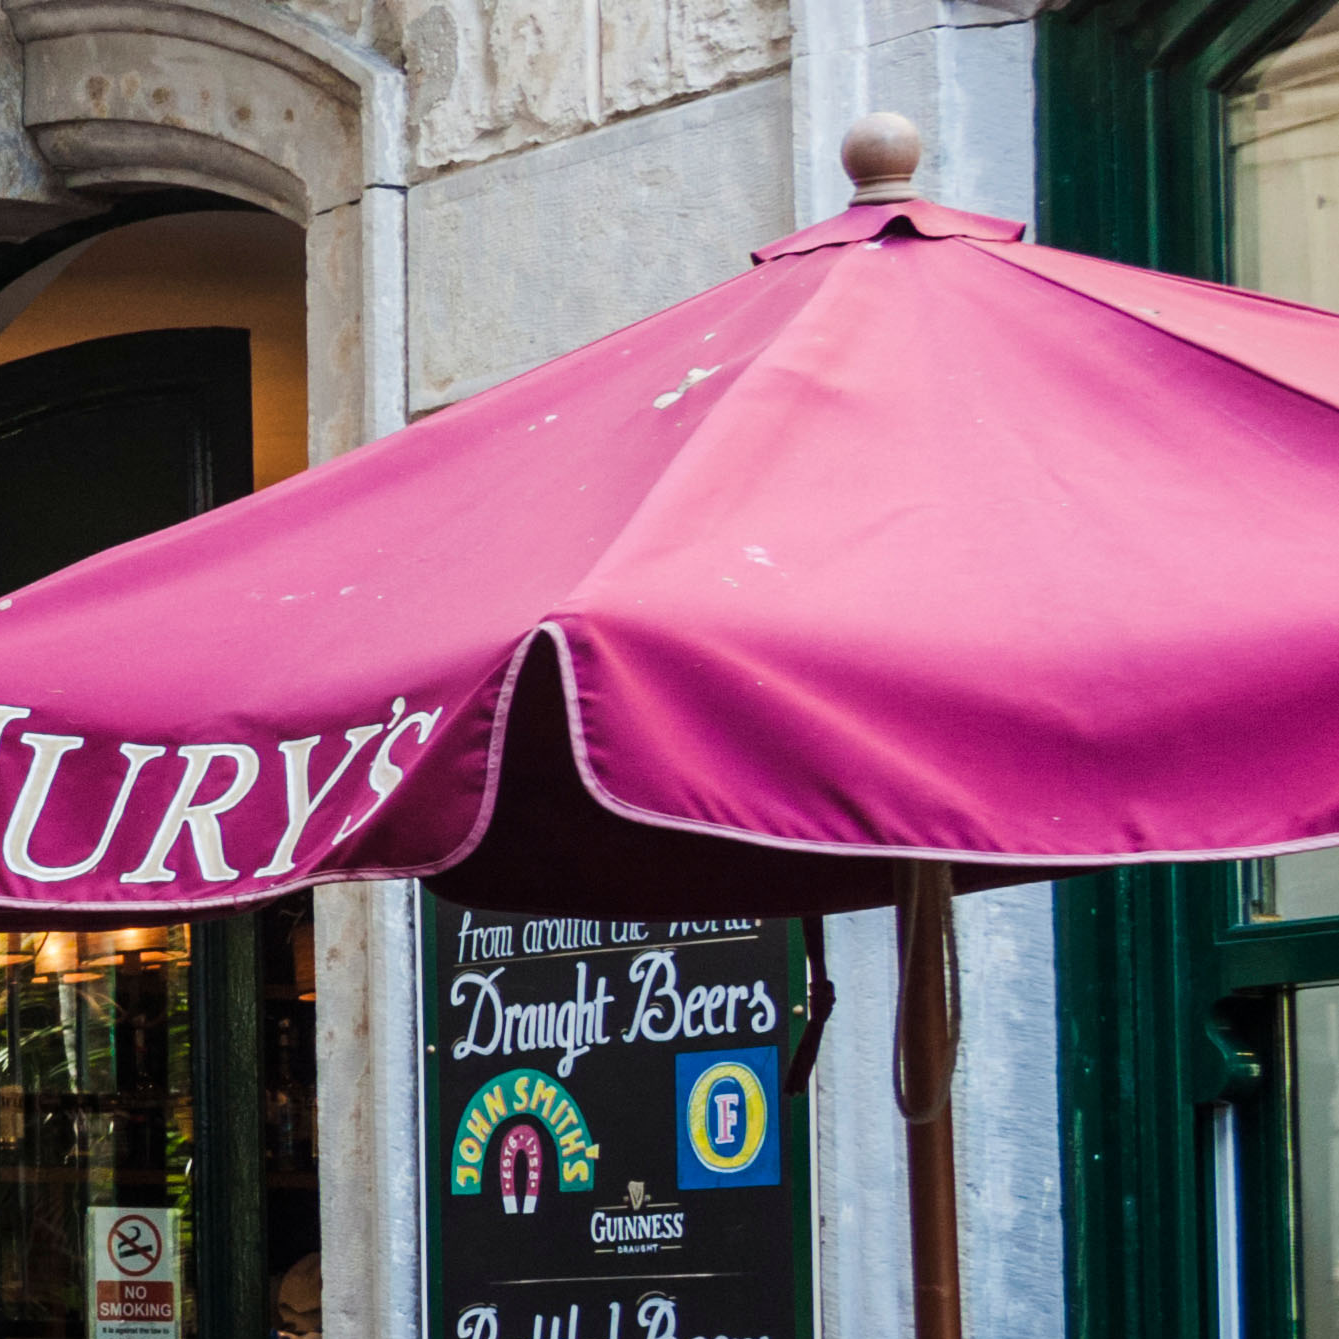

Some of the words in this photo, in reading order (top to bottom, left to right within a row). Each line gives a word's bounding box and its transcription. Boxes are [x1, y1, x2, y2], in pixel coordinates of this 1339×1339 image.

[457, 910, 515, 963] from
[450, 962, 615, 1078] Draught
[621, 949, 777, 1043] Beers
[455, 1084, 508, 1188] JOHN
[713, 1093, 740, 1144] F
[591, 1211, 685, 1244] GUINNESS
[617, 1244, 659, 1254] DRAUGHT
[100, 1302, 172, 1317] SMOKING
[124, 1286, 147, 1300] NO
